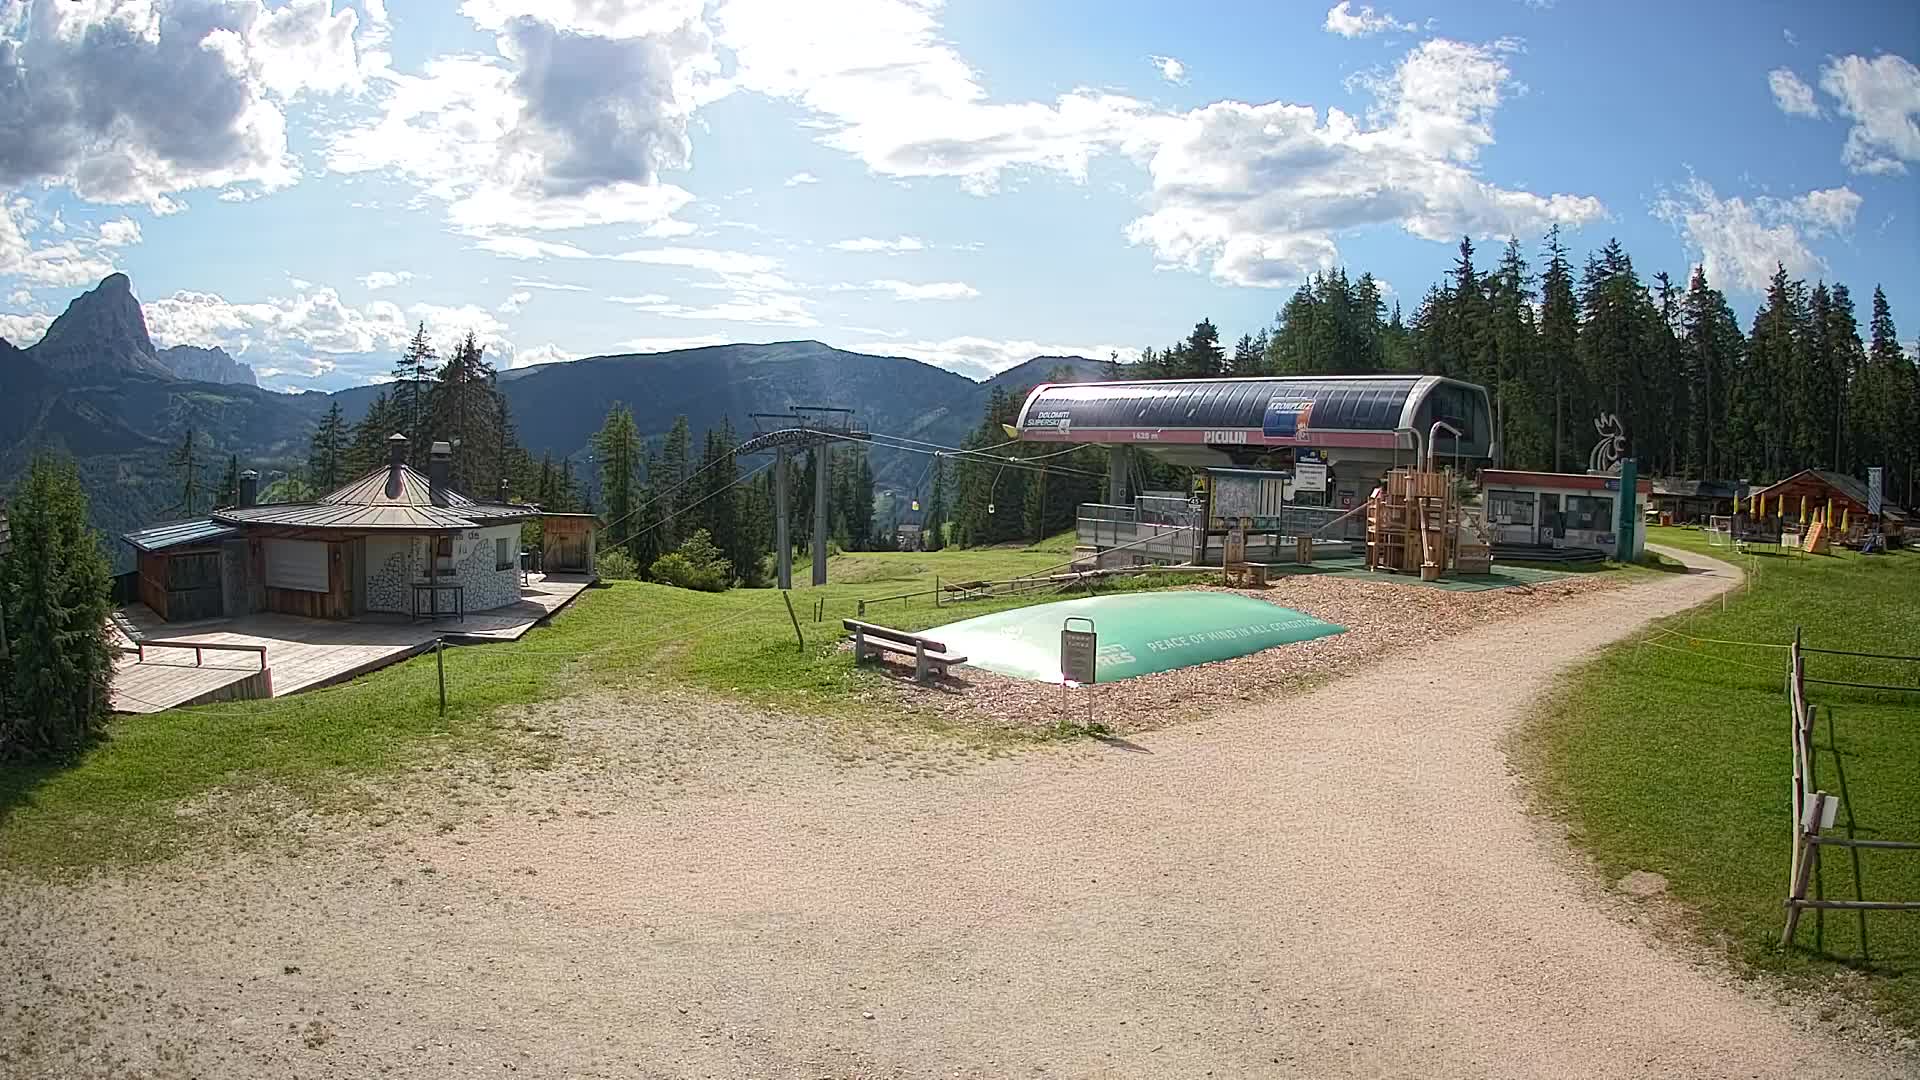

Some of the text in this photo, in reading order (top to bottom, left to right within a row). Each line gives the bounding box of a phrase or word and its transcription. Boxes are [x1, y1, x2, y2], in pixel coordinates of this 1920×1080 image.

[1038, 411, 1070, 419] DOLOMITI
[1203, 431, 1247, 444] PICULIN
[1147, 636, 1191, 653] PEACE
[1190, 633, 1206, 645] OF
[1207, 629, 1237, 641] MIND
[1236, 627, 1250, 638] IN
[1250, 624, 1271, 635] ALL
[1096, 653, 1137, 668] RES
